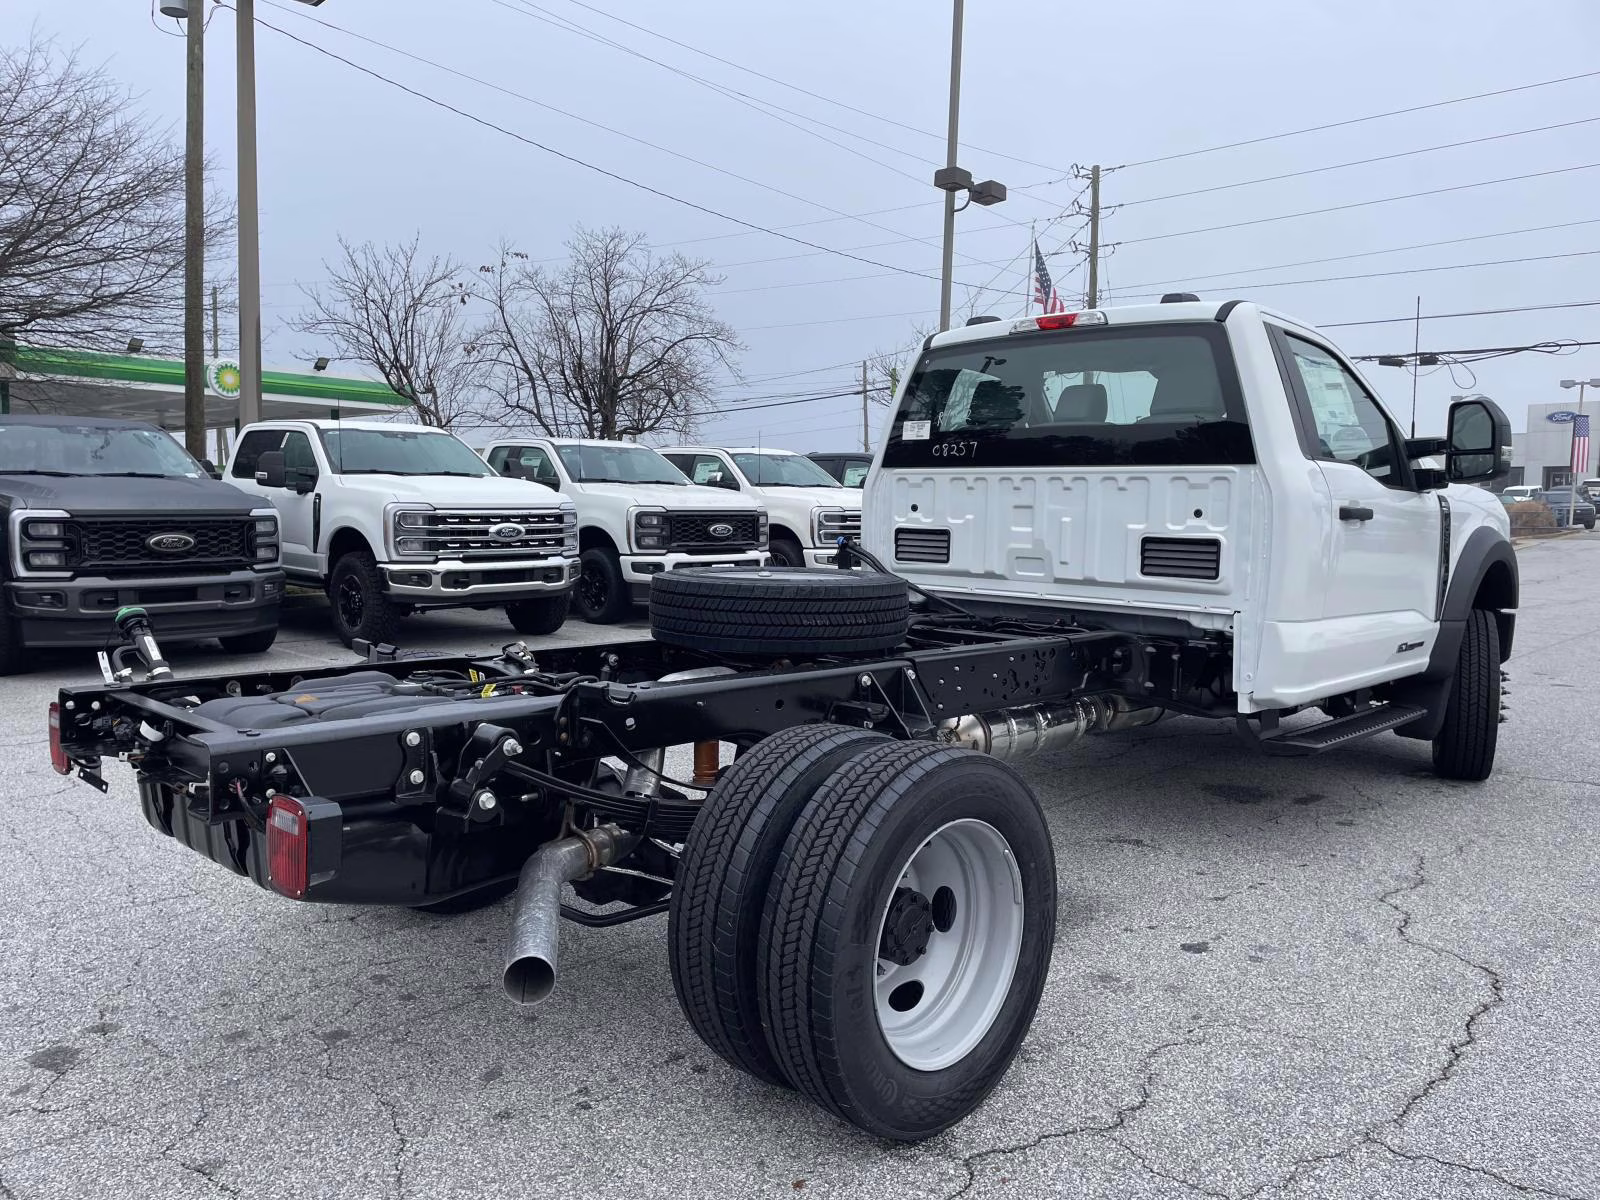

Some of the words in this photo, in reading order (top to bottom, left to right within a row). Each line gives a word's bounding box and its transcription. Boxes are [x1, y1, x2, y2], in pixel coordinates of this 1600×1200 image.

[1552, 413, 1573, 421] Ford
[932, 441, 978, 458] 08257
[500, 528, 517, 537] Ford
[160, 537, 185, 548] Ford
